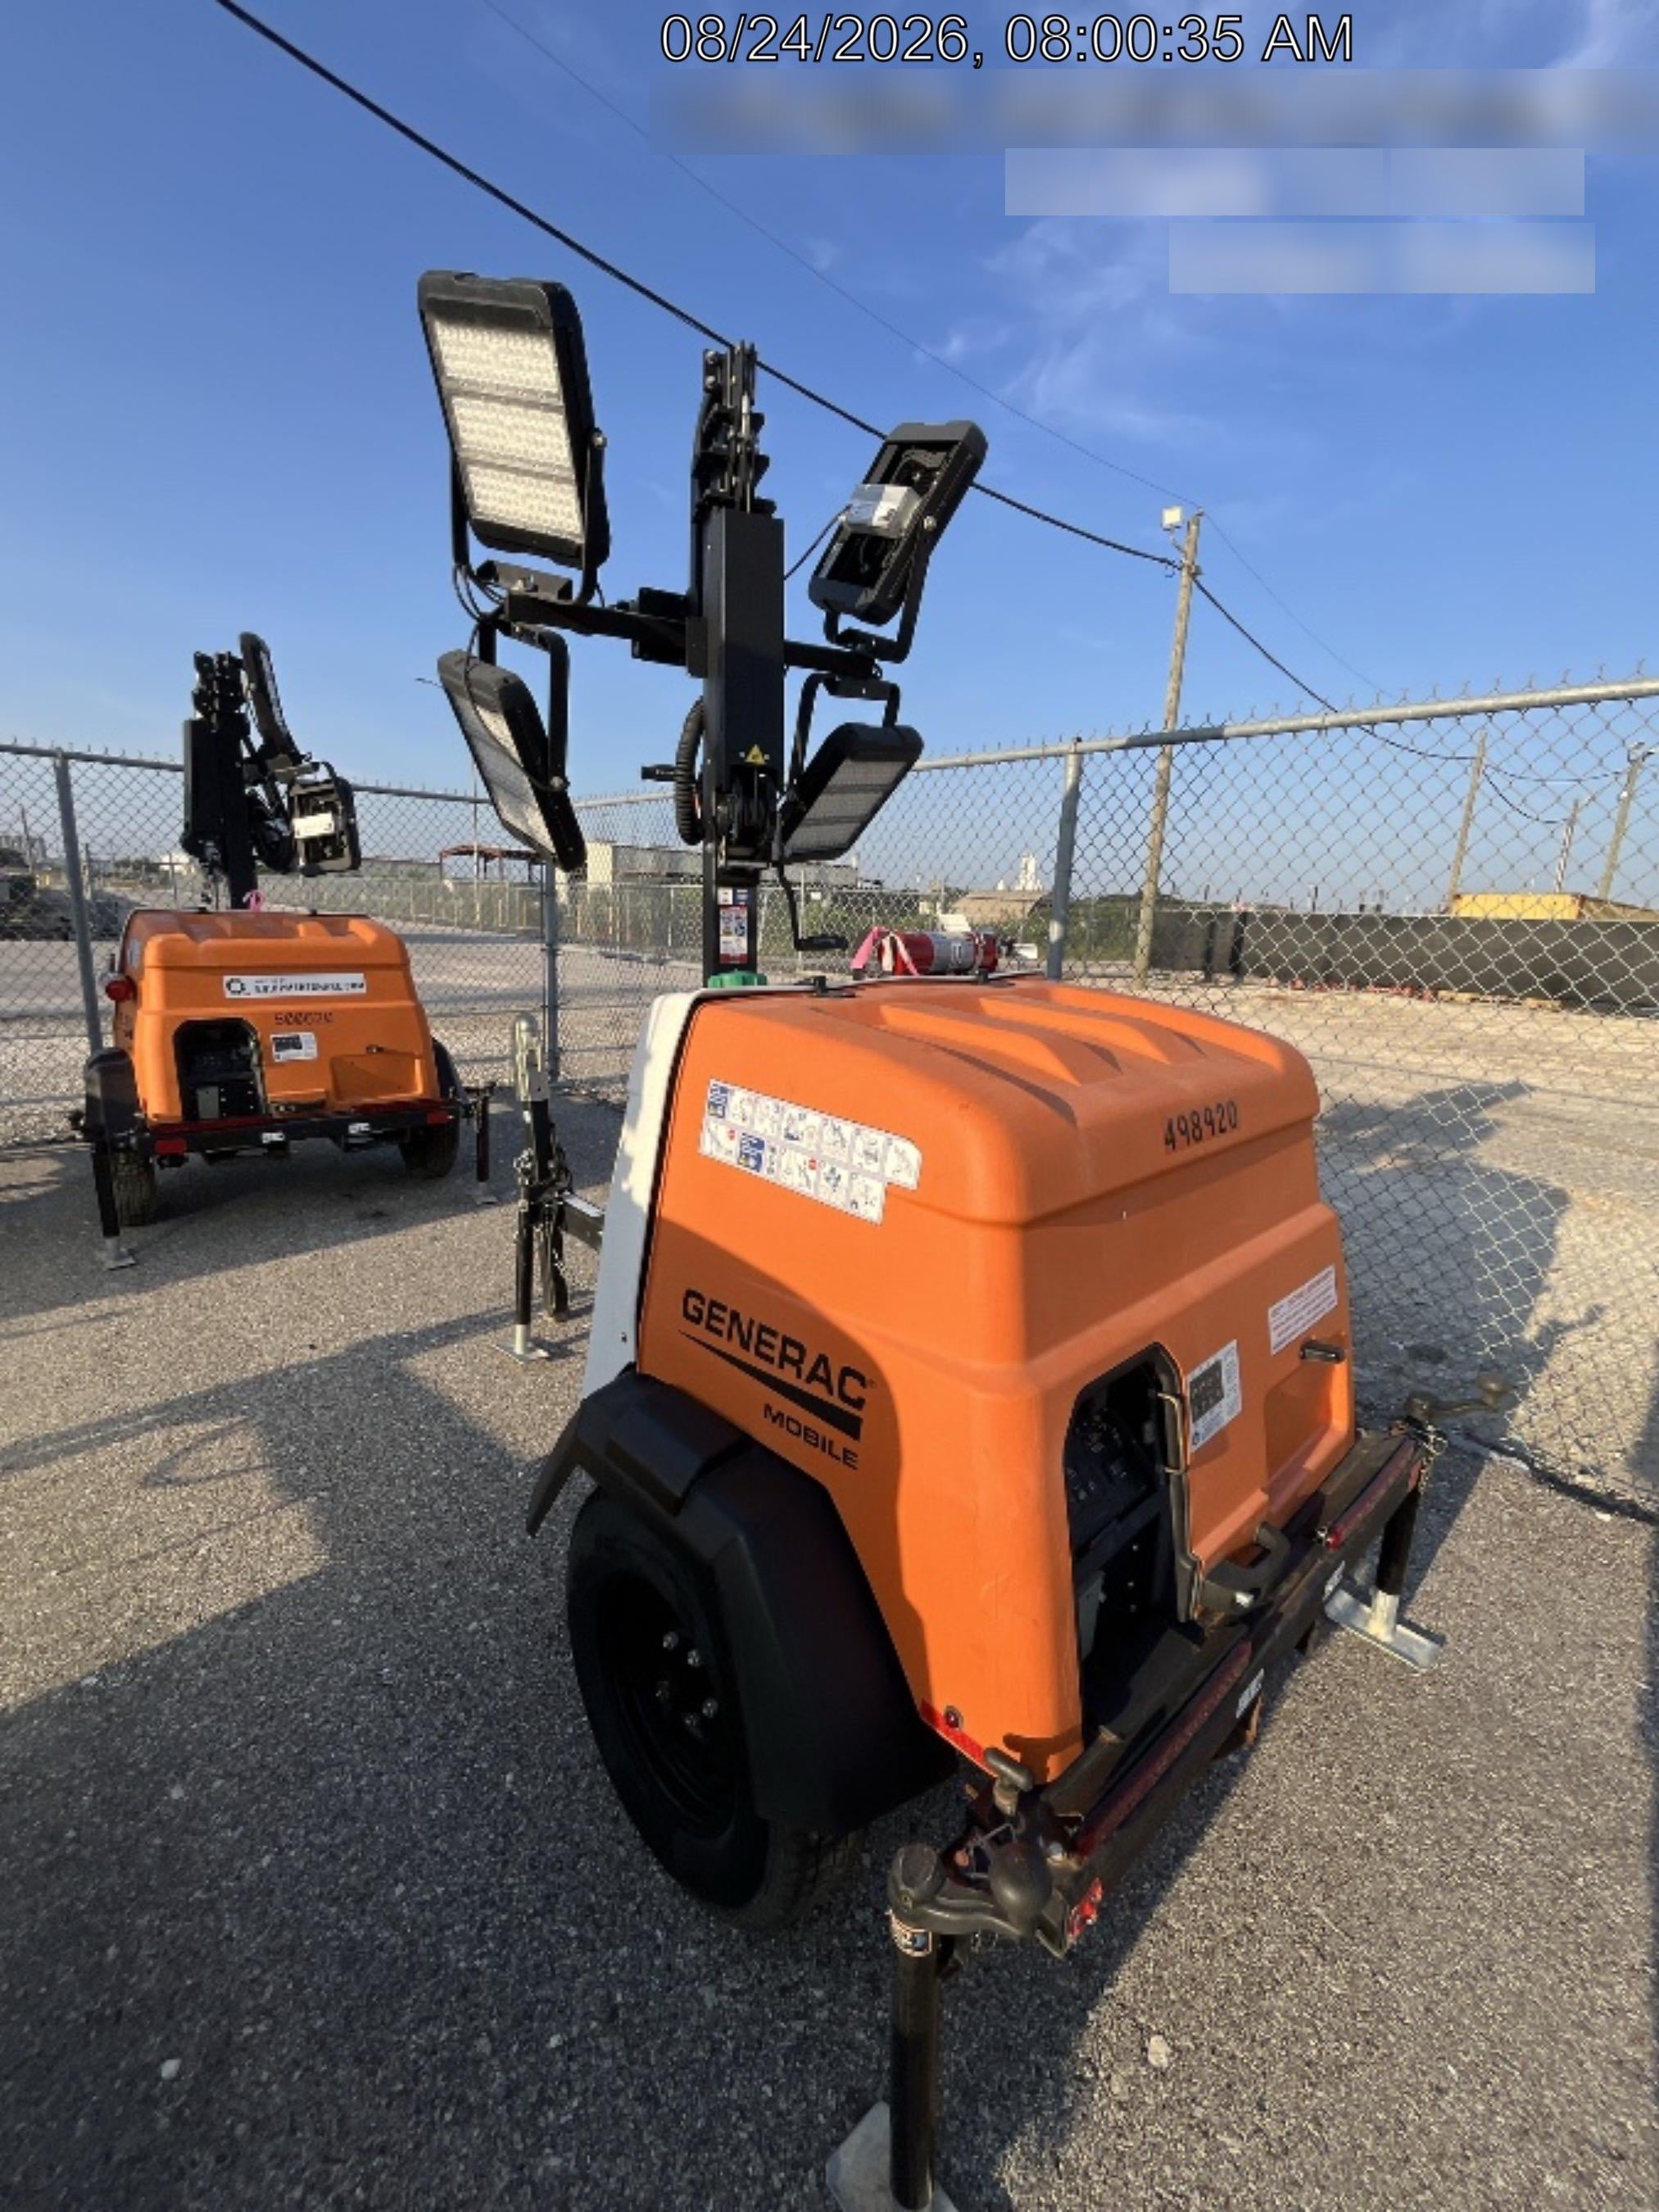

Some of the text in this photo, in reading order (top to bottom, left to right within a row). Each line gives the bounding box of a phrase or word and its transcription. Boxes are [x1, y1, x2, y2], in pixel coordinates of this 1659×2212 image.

[1164, 1100, 1238, 1151] 498920
[682, 1288, 867, 1411] GENERAC
[763, 1402, 859, 1471] MOBILE
